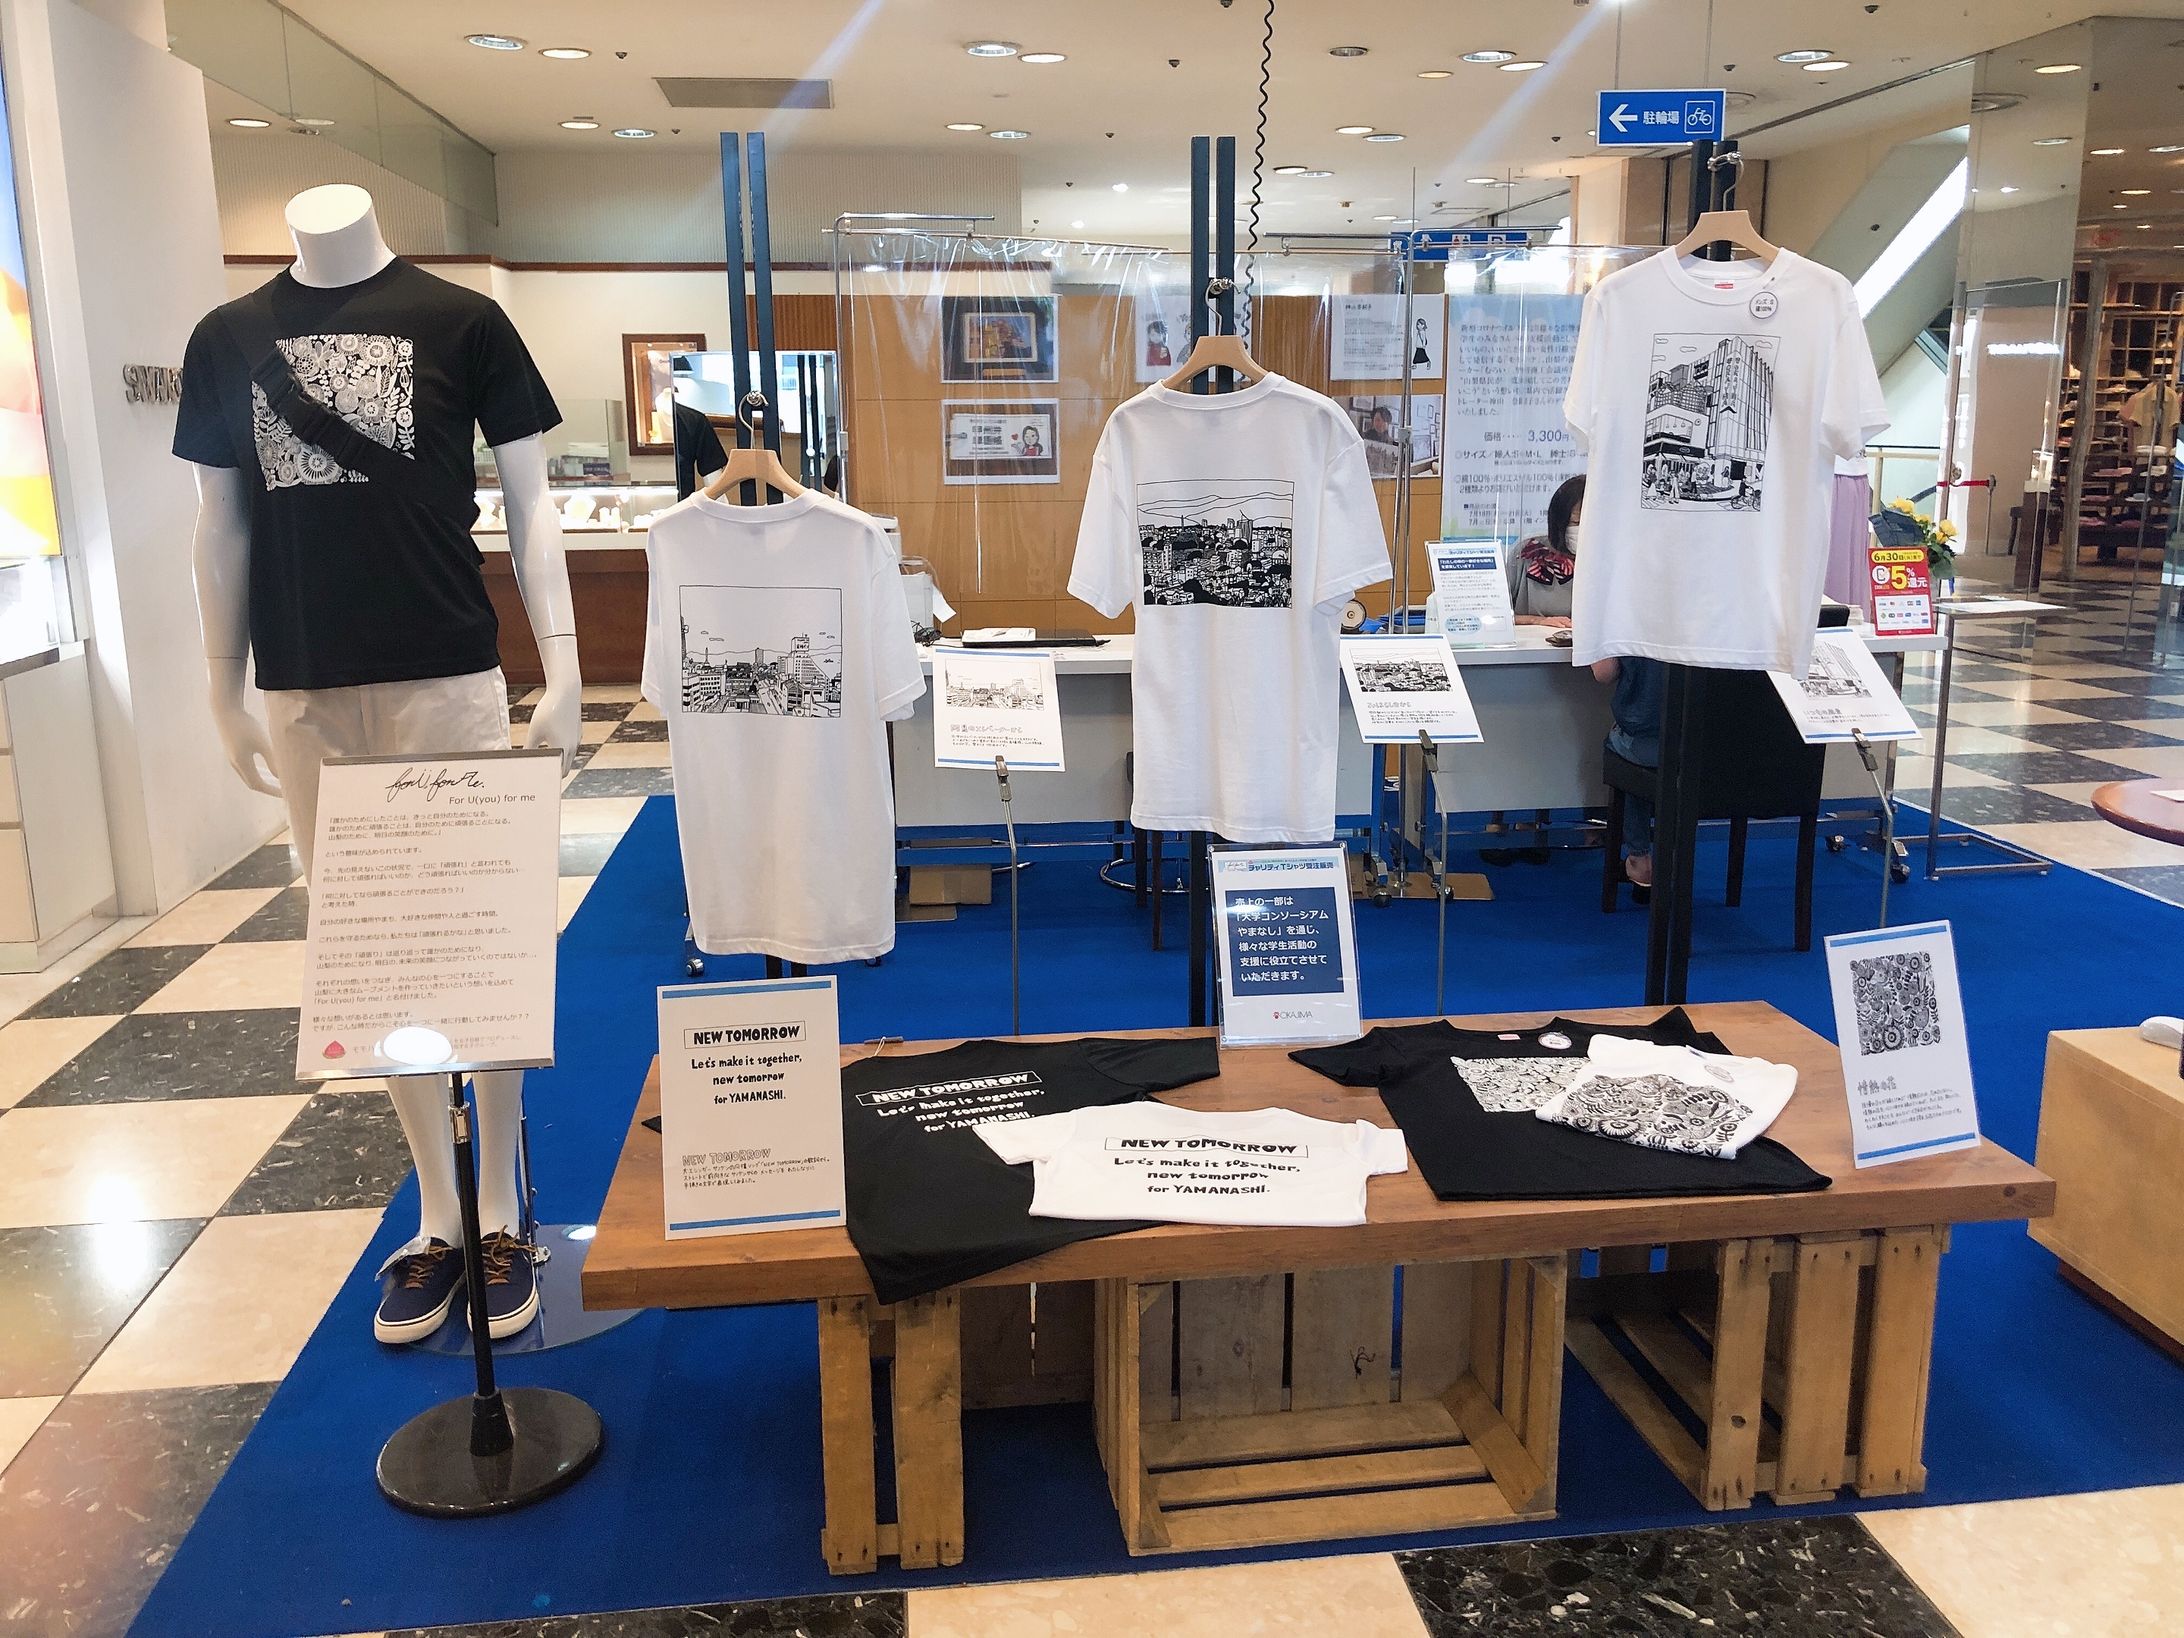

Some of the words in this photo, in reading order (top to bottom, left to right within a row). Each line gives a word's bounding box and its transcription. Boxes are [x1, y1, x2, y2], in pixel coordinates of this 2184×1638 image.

[1642, 110, 1680, 125] 駐輪場
[449, 796, 464, 805] For
[468, 795, 501, 806] U(you)
[504, 794, 518, 803] for
[520, 794, 536, 802] me
[1235, 896, 1294, 906] 売上の一部は
[1236, 910, 1329, 922] 「大学コンソーシアム
[1238, 925, 1320, 937] やまなし」を通じ、
[1239, 940, 1317, 951] 様々な学生活動の
[1240, 955, 1327, 966] 支援に役立てさせて
[1241, 971, 1305, 982] いただきます。
[1280, 1011, 1313, 1020] OKAJIMA
[694, 1030, 723, 1045] NEW
[726, 1025, 800, 1042] TOMORROW
[691, 1056, 716, 1069] Let's
[719, 1055, 743, 1067] make
[745, 1056, 754, 1066] it
[757, 1052, 802, 1067] together,
[713, 1076, 734, 1085] new
[737, 1072, 784, 1084] tomorrow
[872, 1089, 916, 1103] NEW
[918, 1074, 1028, 1096] TOMORROW
[714, 1095, 727, 1104] for
[729, 1089, 786, 1103] YAMANASHI.
[877, 1105, 915, 1117] Let's
[919, 1100, 957, 1110] make
[960, 1097, 973, 1106] it
[977, 1089, 1045, 1103] together,
[915, 1111, 948, 1122] new
[951, 1101, 1024, 1116] tomorrow
[924, 1123, 945, 1133] for
[945, 1111, 1035, 1130] YAMANASHI.
[1121, 1139, 1169, 1148] NEW
[1174, 1138, 1298, 1154] TOMORROW
[682, 1154, 707, 1166] NEW
[709, 1148, 771, 1164] TOMORROW
[1114, 1157, 1154, 1166] Let's
[1160, 1158, 1200, 1167] make
[1205, 1159, 1219, 1168] it
[1225, 1159, 1300, 1172] together,
[1147, 1171, 1183, 1179] new
[1189, 1172, 1269, 1181] tomorrow
[1147, 1185, 1169, 1193] for
[1173, 1184, 1270, 1195] YAMANASHI.
